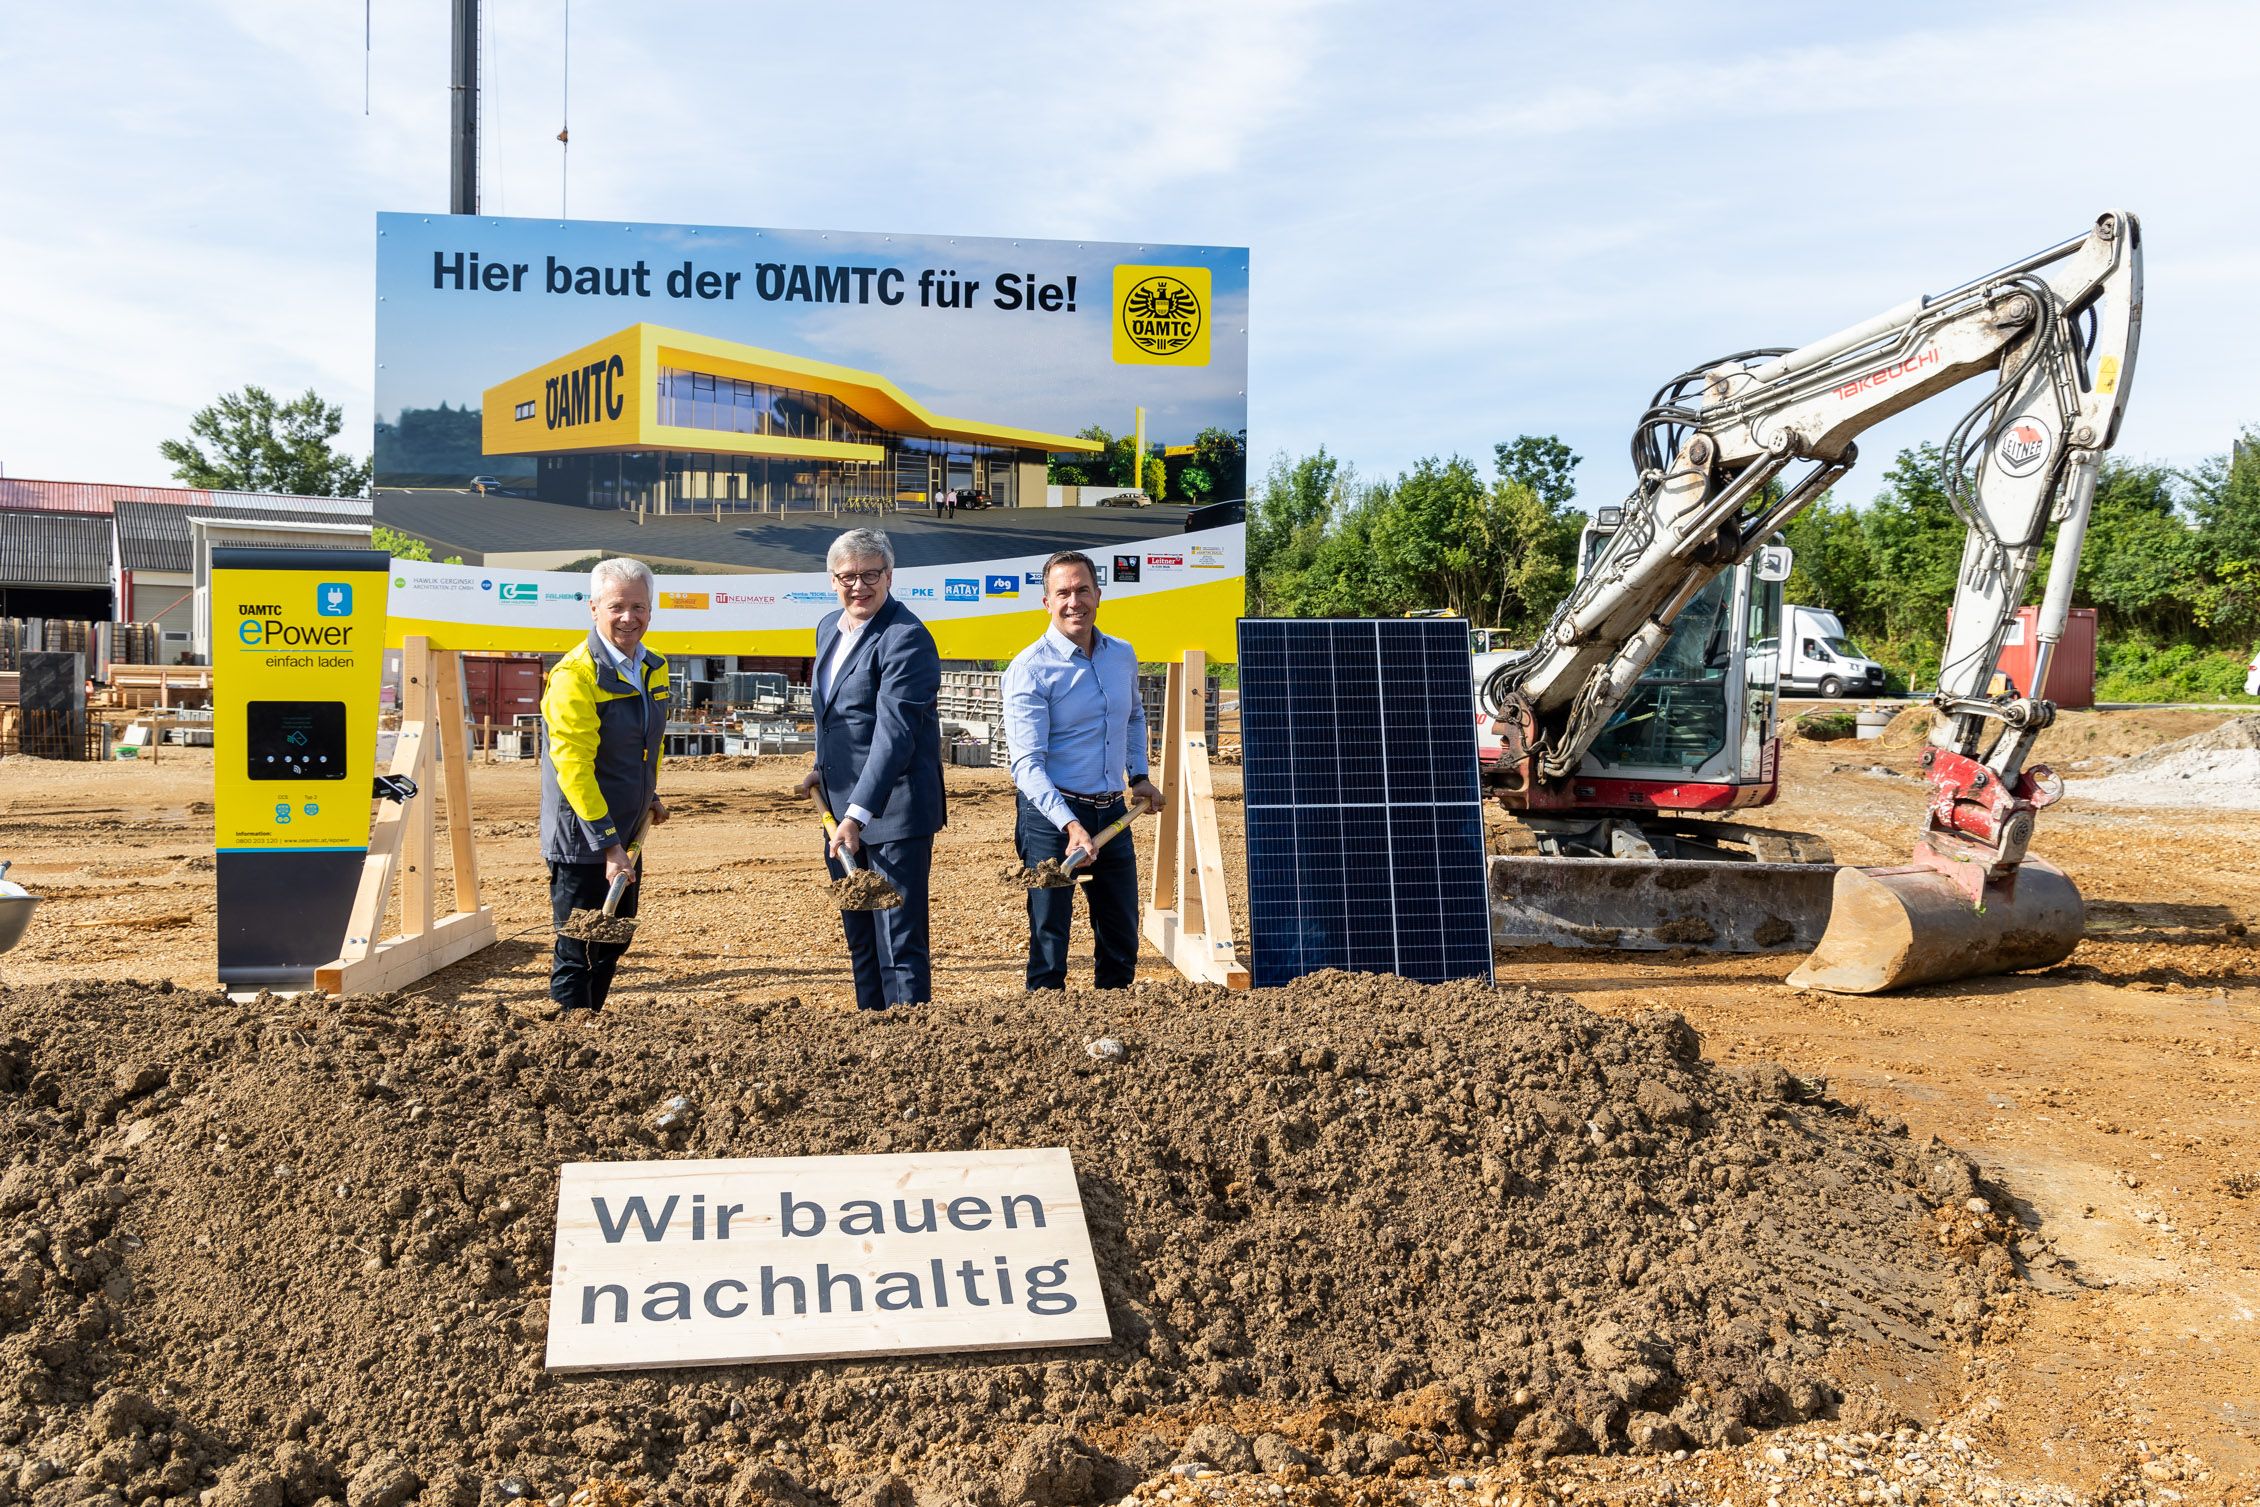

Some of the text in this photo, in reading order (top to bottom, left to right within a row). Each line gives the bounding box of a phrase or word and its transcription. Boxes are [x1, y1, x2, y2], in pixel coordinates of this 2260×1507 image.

[433, 251, 1078, 312] Hier baut der ÖAMTC für Sie!
[1132, 319, 1192, 338] ÖAMTC
[1832, 348, 1939, 400] TAKEUCHI
[545, 354, 625, 430] ÖAMTC
[2003, 438, 2042, 459] LEITNER
[1151, 557, 1176, 565] Leitner
[911, 588, 934, 597] PKE
[945, 583, 979, 595] RATAY
[993, 578, 1011, 590] sbg
[728, 595, 775, 603] NEUMAYER
[238, 604, 282, 616] ÖAMTC
[238, 619, 353, 646] ePower
[265, 655, 354, 668] einfach laden
[591, 1191, 1047, 1244] Wir bauen
[580, 1255, 1078, 1325] nachhaltig
